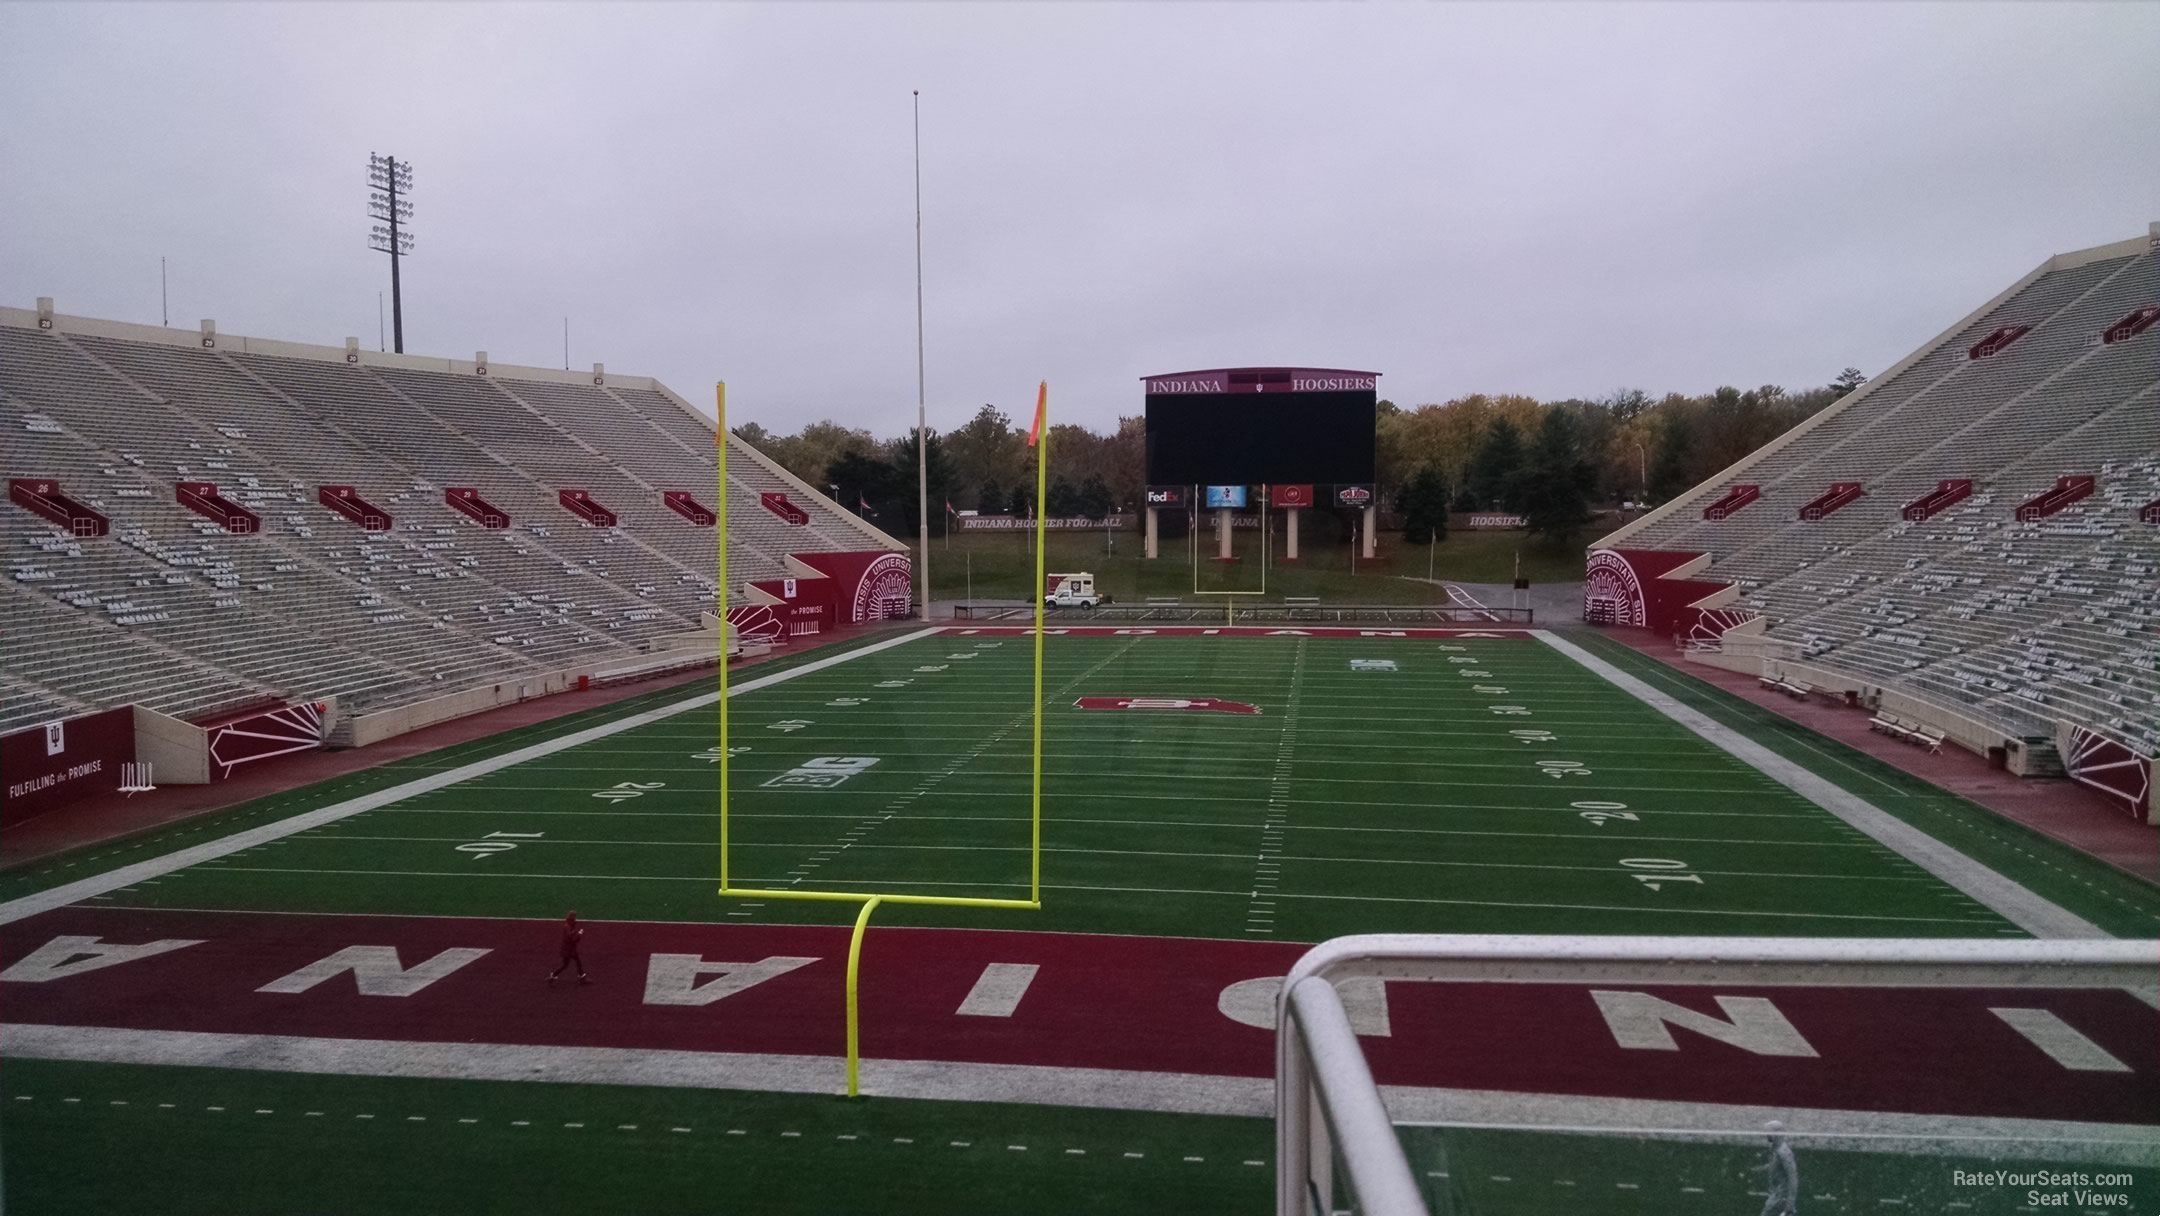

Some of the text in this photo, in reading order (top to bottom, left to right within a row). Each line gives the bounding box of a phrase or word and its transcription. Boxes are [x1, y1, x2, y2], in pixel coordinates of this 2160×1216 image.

[1151, 380, 1221, 393] INDIANA
[1292, 377, 1375, 392] HOOSIERS
[38, 484, 48, 493] 26
[200, 487, 208, 495] 27
[1148, 491, 1179, 502] FedEx
[964, 519, 1012, 529] INDIANA
[1015, 519, 1063, 529] HOOIER
[1210, 517, 1259, 527] INIANA
[799, 606, 823, 615] PROMISE
[1535, 760, 1593, 776] 30
[9, 774, 55, 799] FULFILLING
[68, 759, 102, 781] PROMISE
[591, 781, 666, 799] 20
[1570, 800, 1640, 822] 20
[455, 831, 545, 853] 10
[1618, 857, 1704, 885] 10
